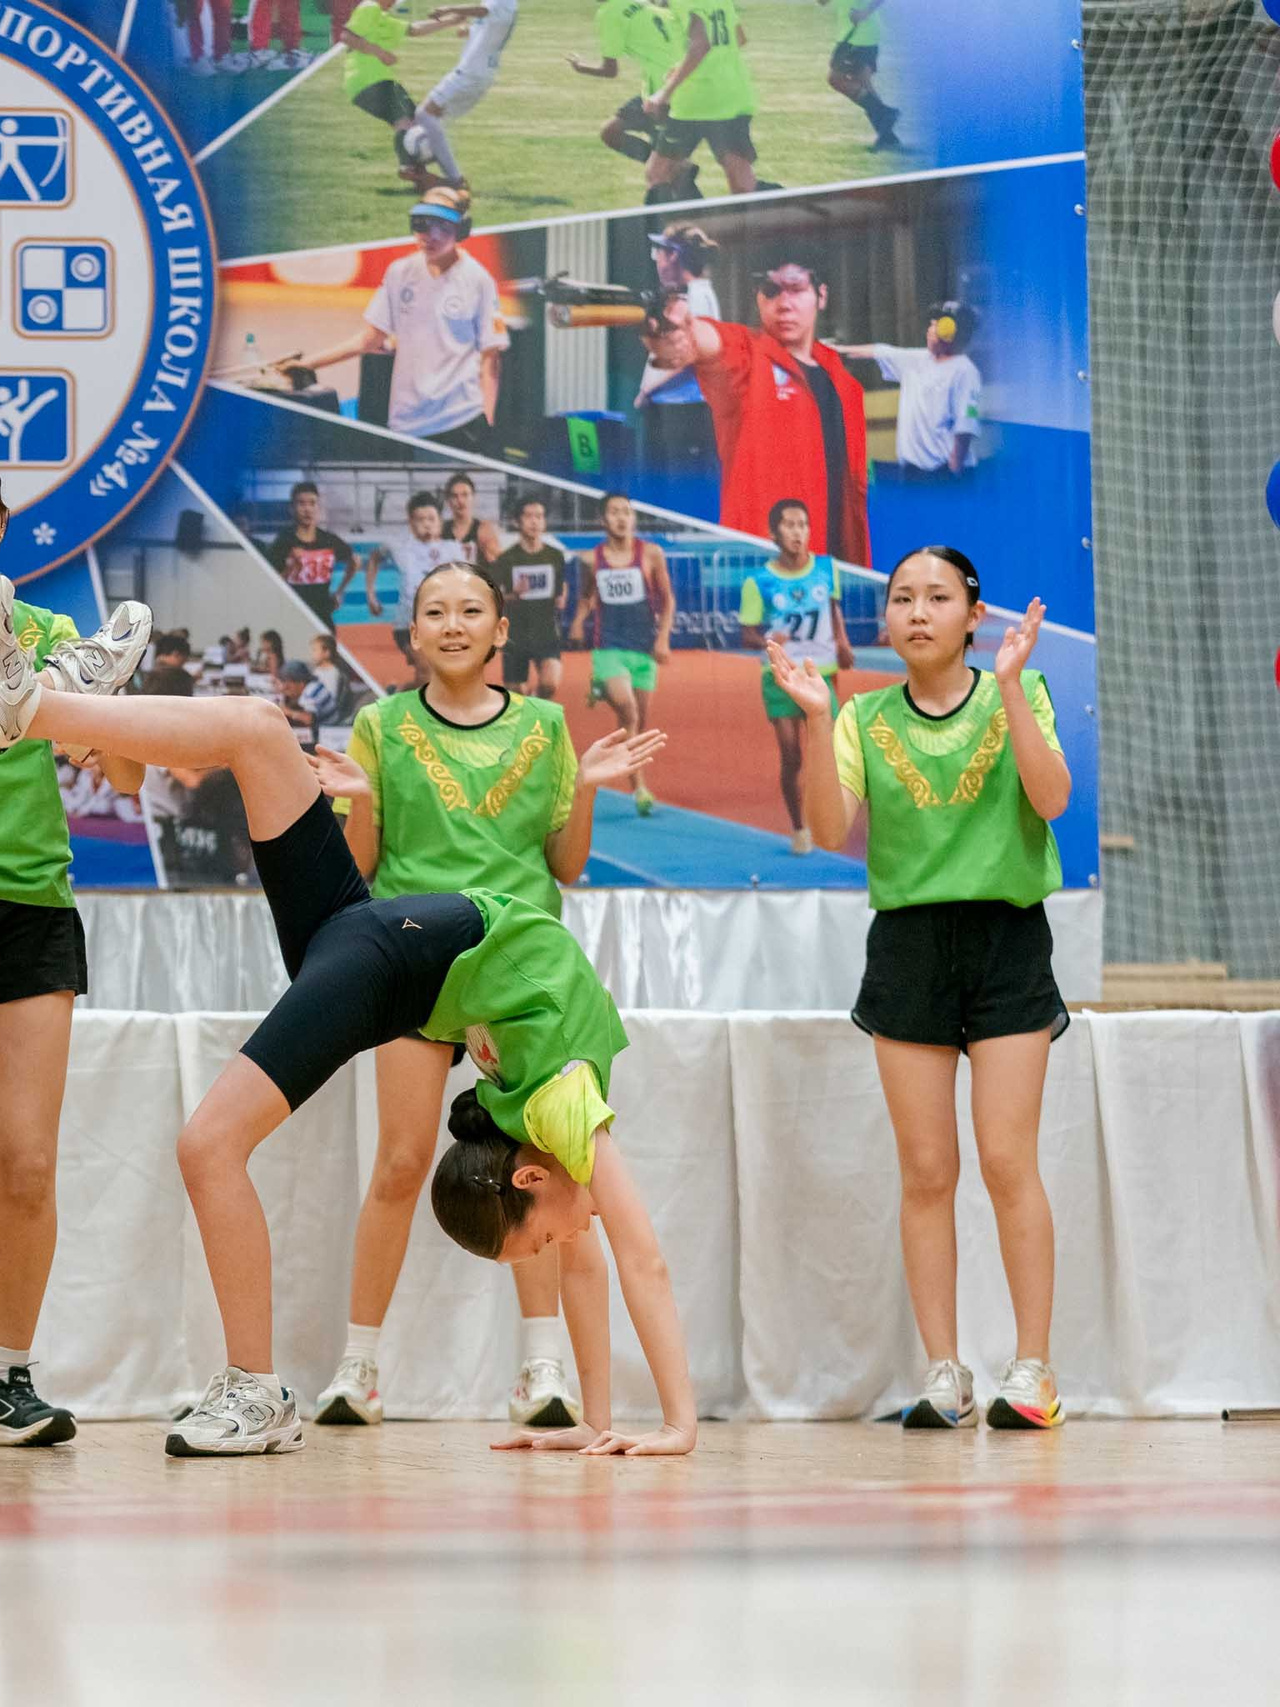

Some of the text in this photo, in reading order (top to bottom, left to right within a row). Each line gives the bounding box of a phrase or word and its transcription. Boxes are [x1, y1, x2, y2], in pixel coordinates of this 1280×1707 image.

[142, 246, 202, 411] ШКОЛА
[89, 420, 160, 497] №4»
[607, 581, 633, 598] 200
[785, 610, 820, 642] 27
